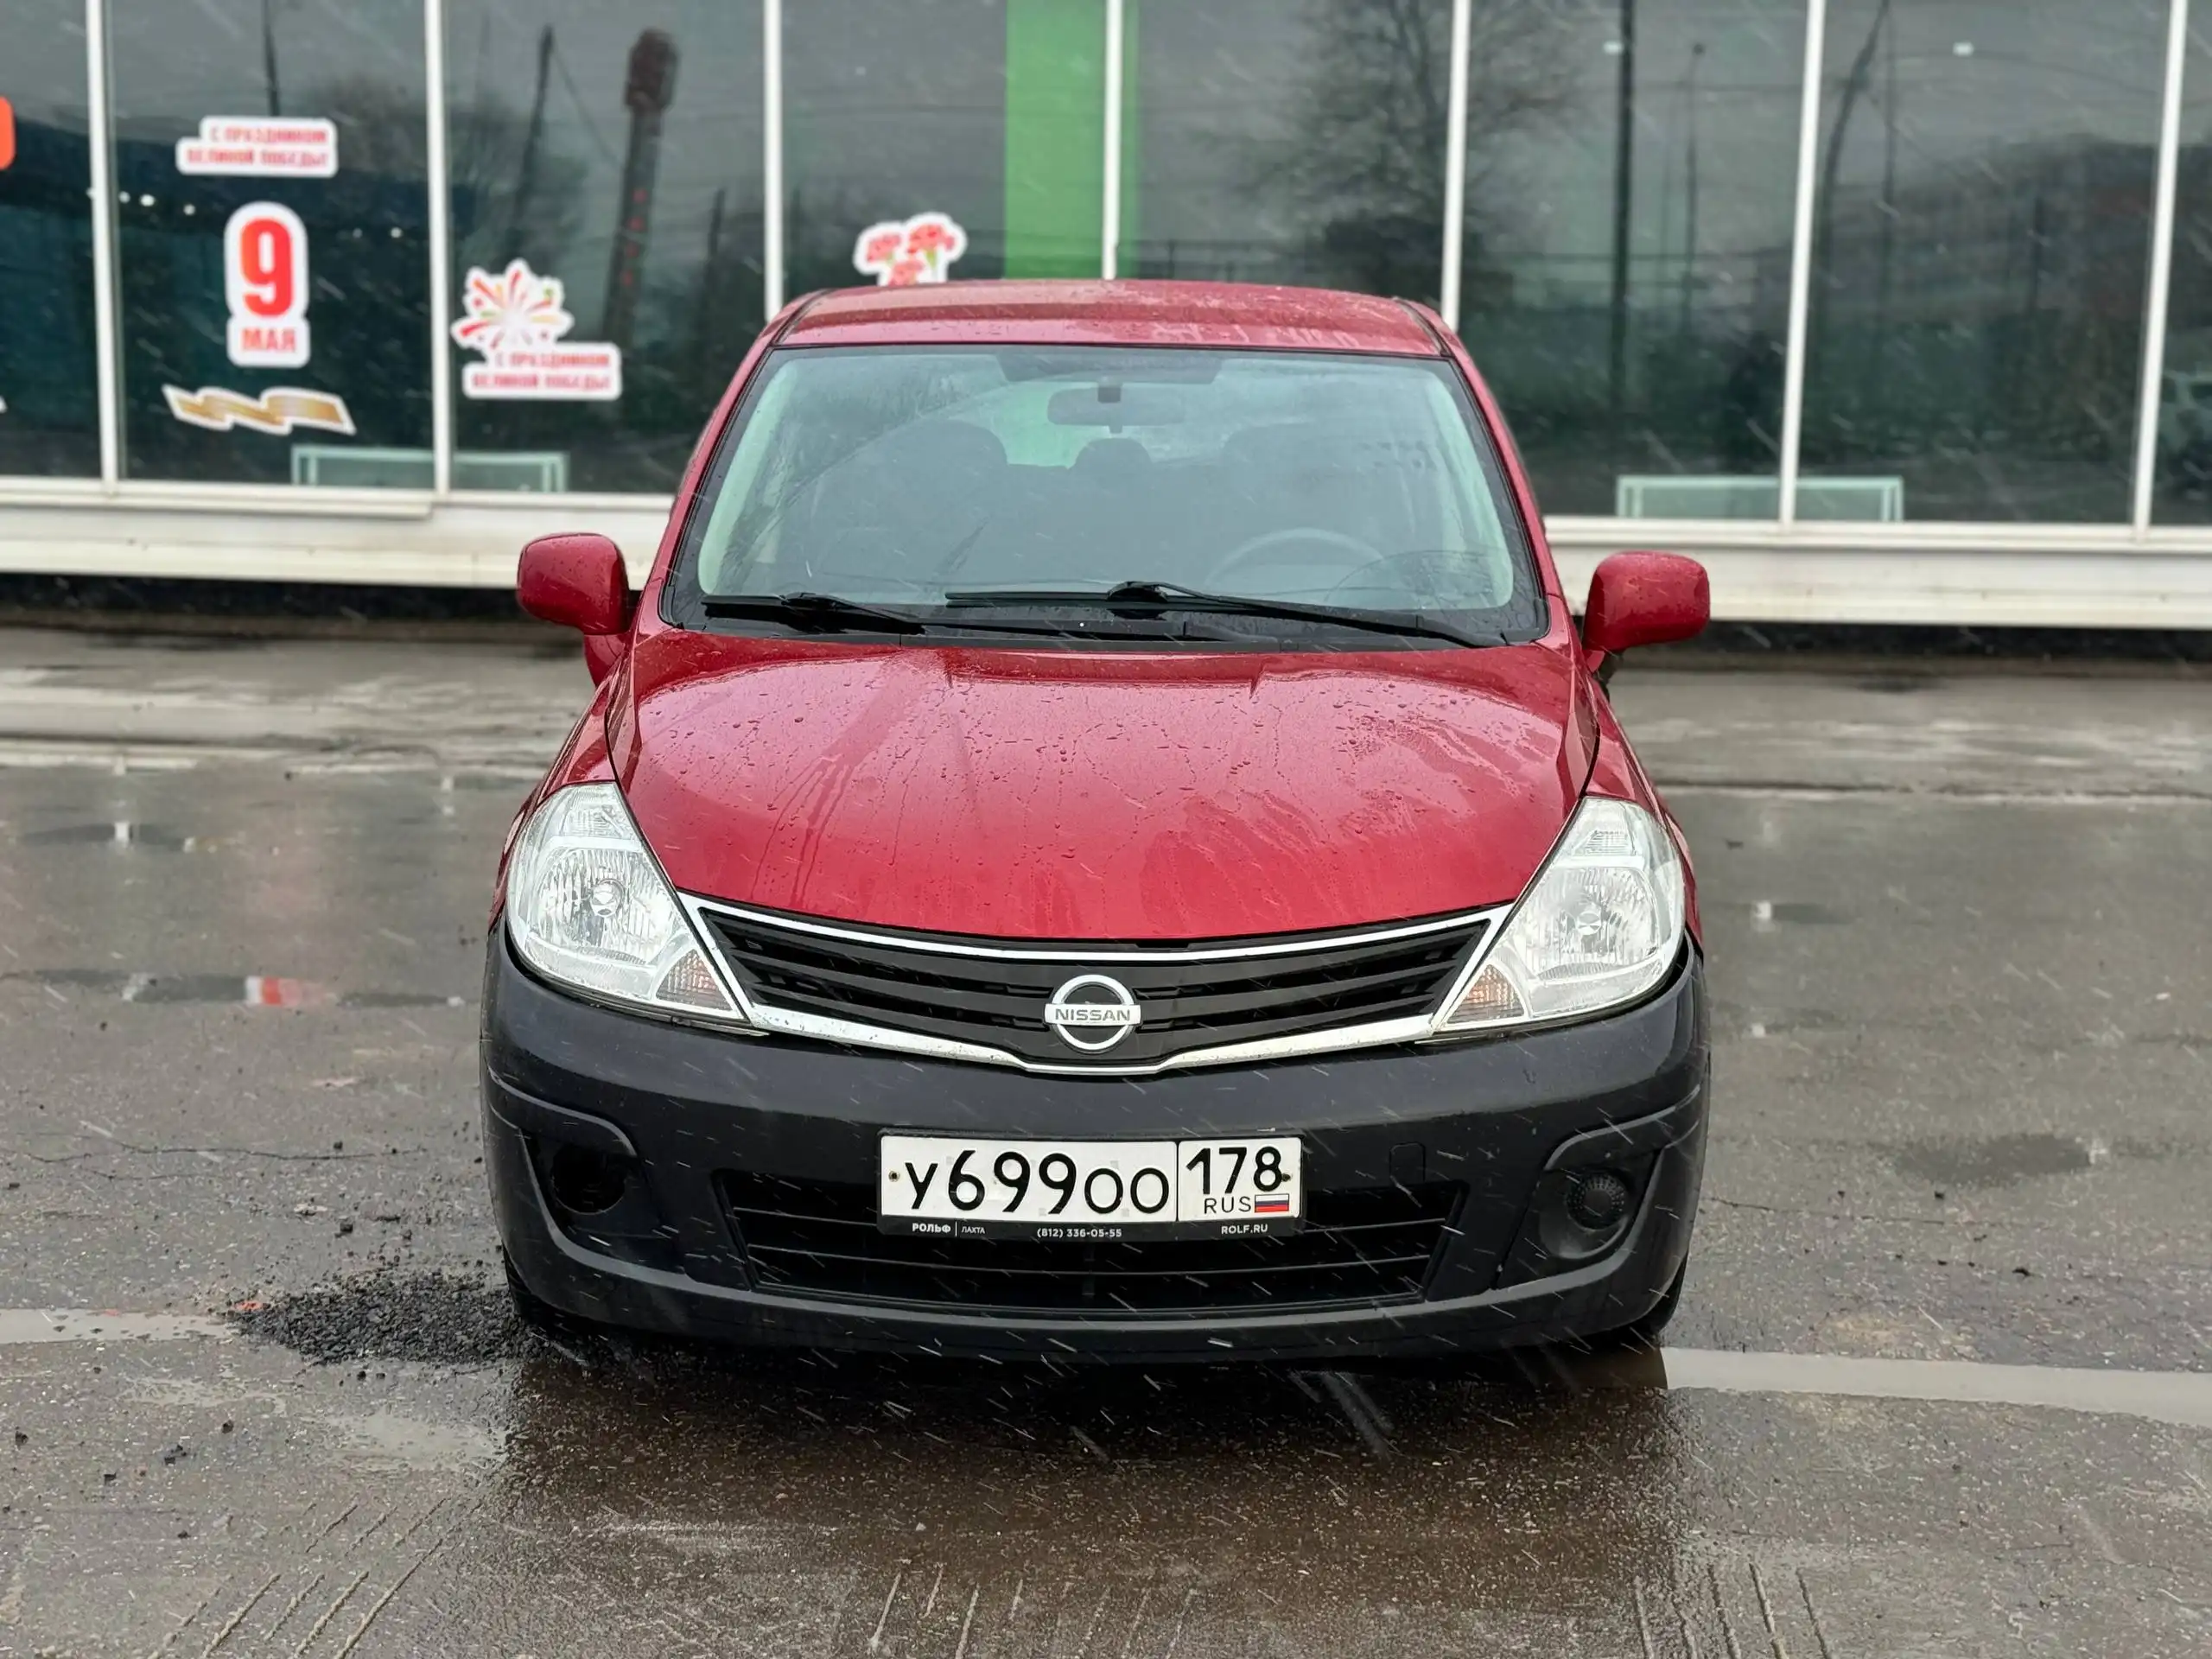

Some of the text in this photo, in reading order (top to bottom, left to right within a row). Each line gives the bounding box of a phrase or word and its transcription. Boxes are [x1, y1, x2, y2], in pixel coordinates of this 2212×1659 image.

[241, 218, 292, 316] 9
[242, 327, 296, 353] МАЯ
[1055, 1007, 1130, 1021] NISSAN
[1185, 1146, 1282, 1195] 178
[1204, 1196, 1251, 1214] RUS
[912, 1223, 985, 1235] РОЛЬФ ЛАХТА
[1037, 1228, 1122, 1238] (812) 336-05-55
[1221, 1224, 1268, 1235] ROLF.RU
